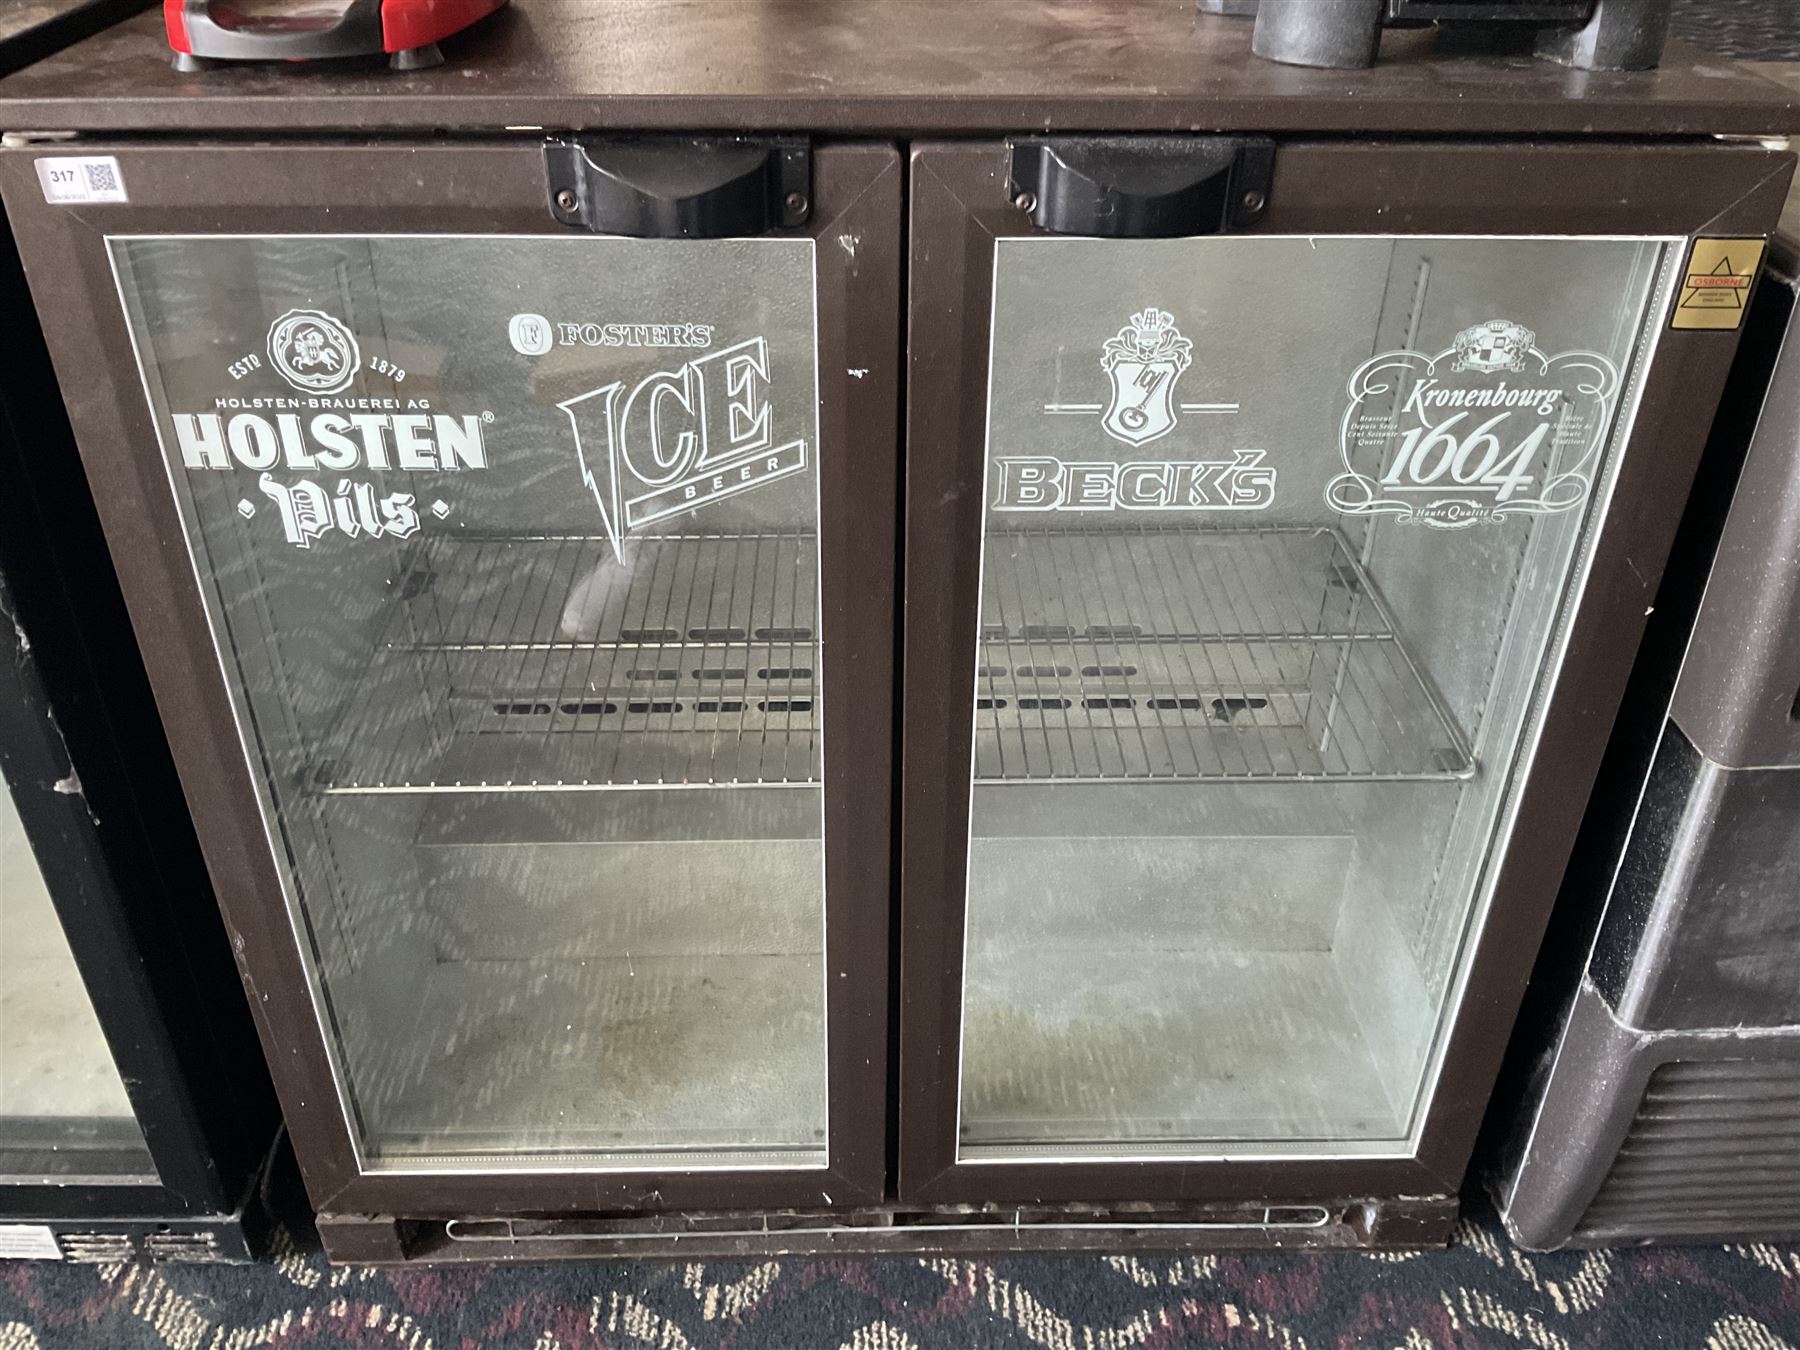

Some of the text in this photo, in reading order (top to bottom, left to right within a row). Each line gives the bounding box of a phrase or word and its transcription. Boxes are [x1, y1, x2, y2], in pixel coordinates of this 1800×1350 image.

[50, 170, 74, 182] 317
[1695, 278, 1744, 286] OSBORNE
[557, 322, 712, 348] FOSTER'S
[227, 353, 407, 383] ESTD 1879
[215, 397, 430, 410] HOLSTEN-BRAUEREI AG
[1402, 379, 1562, 429] Kronenbourg
[555, 335, 771, 567] ICE
[1381, 411, 1549, 501] 1664
[684, 456, 779, 500] BEER
[258, 472, 421, 549] Pils
[1416, 508, 1446, 517] Haute
